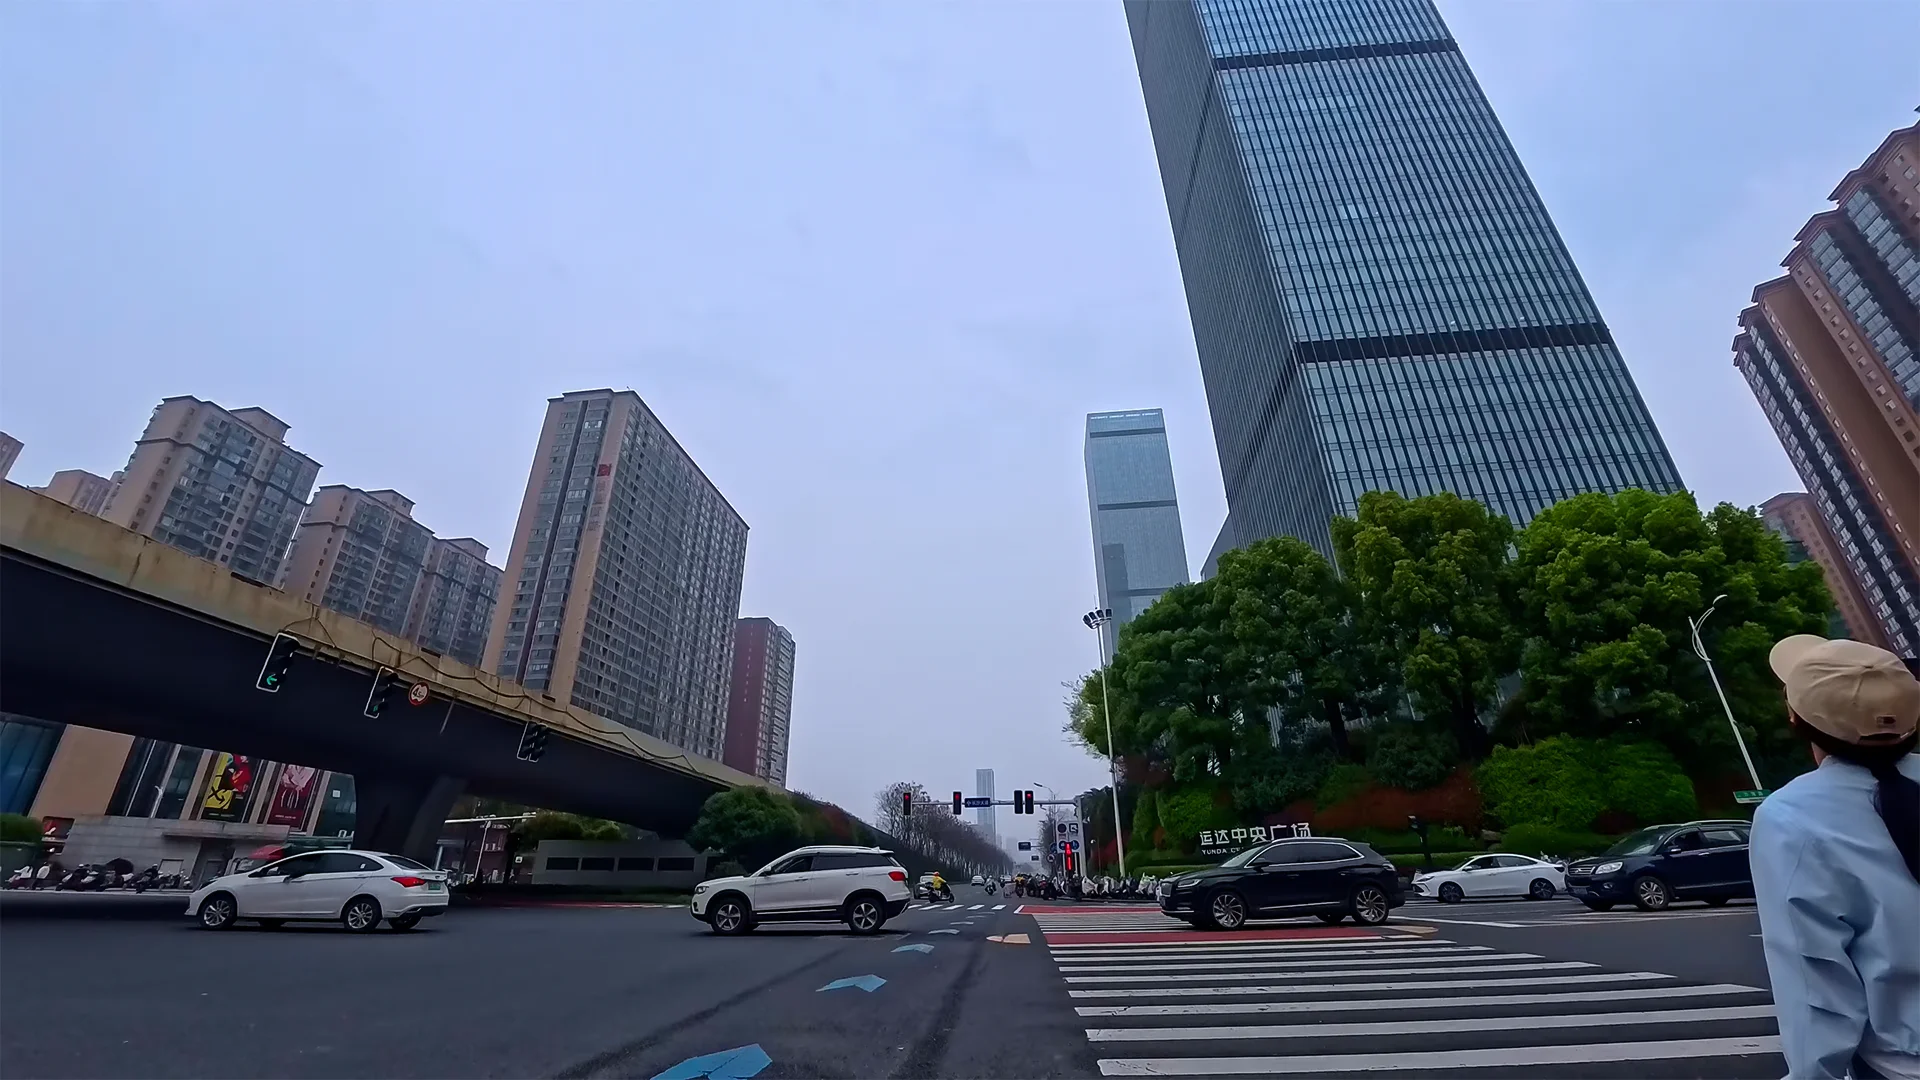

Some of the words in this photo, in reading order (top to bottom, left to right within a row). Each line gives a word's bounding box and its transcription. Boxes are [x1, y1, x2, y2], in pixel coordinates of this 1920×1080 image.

[1199, 822, 1311, 846] 运达中央广场
